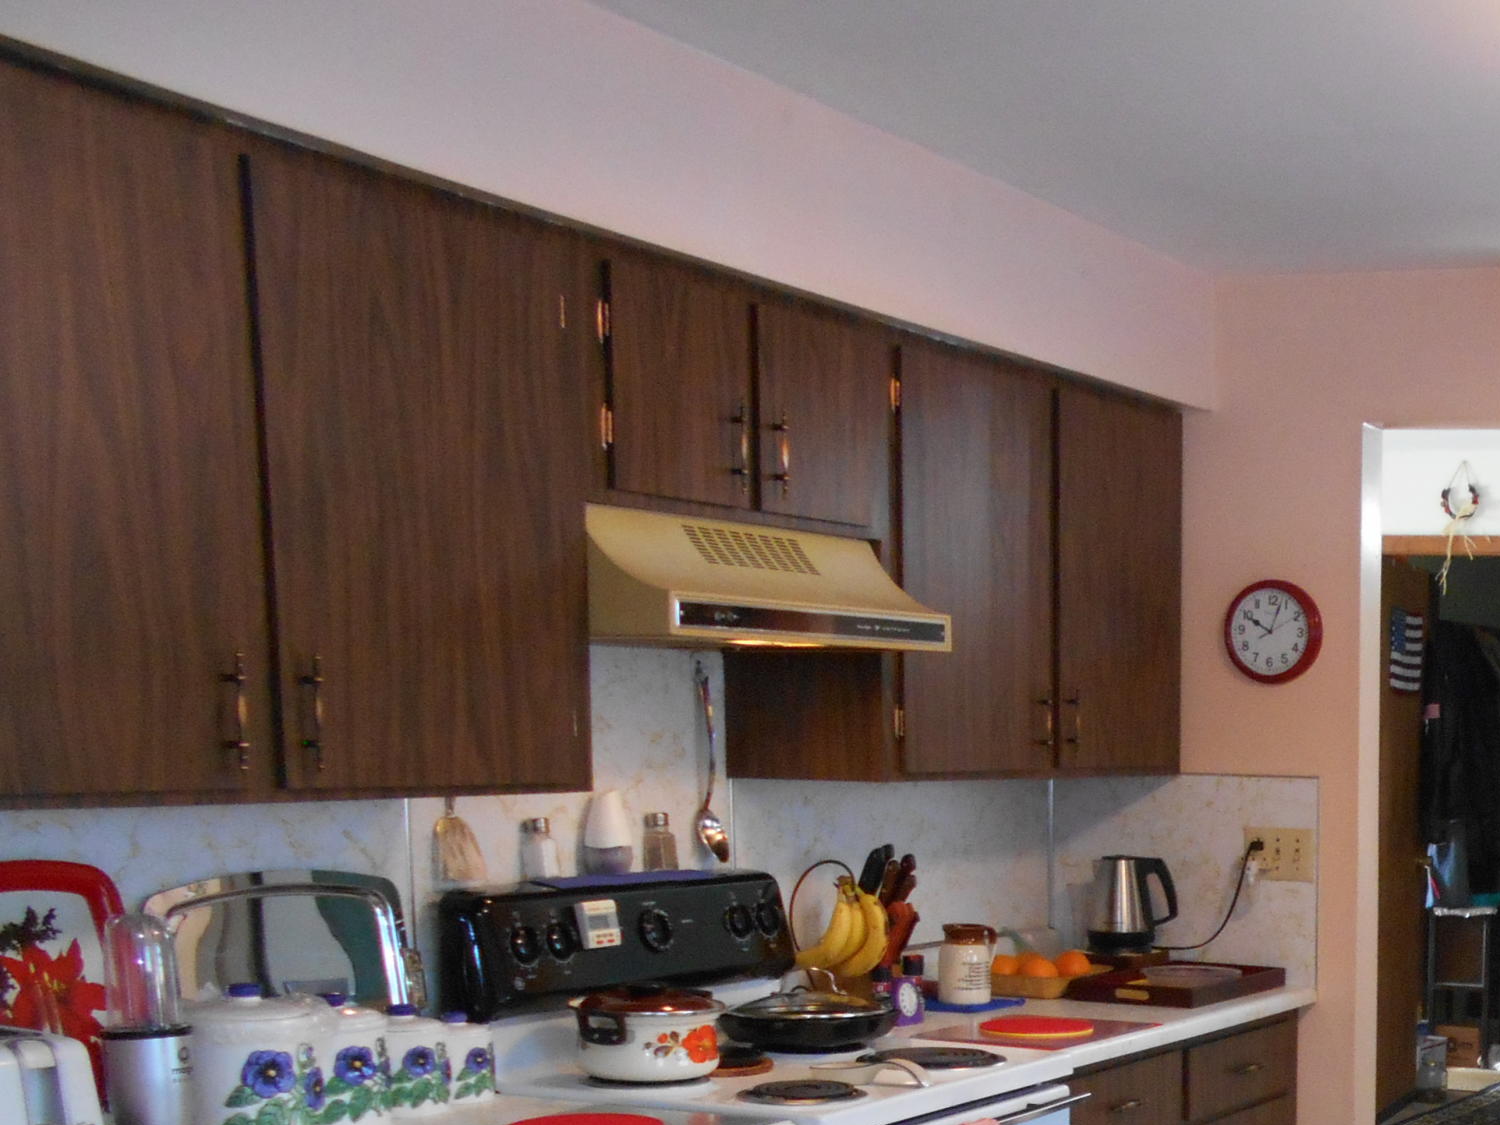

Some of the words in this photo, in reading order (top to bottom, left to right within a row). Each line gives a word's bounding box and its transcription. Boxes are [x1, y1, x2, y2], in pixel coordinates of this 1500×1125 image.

[1268, 595, 1278, 606] 12
[1243, 610, 1254, 620] 10
[1294, 611, 1301, 621] 2
[1238, 625, 1246, 635] 9
[1297, 627, 1304, 638] 3
[1242, 641, 1249, 651] 8
[1292, 642, 1299, 653] 4
[1252, 652, 1259, 662] 7
[1266, 657, 1273, 667] 6
[1281, 653, 1288, 664] 5
